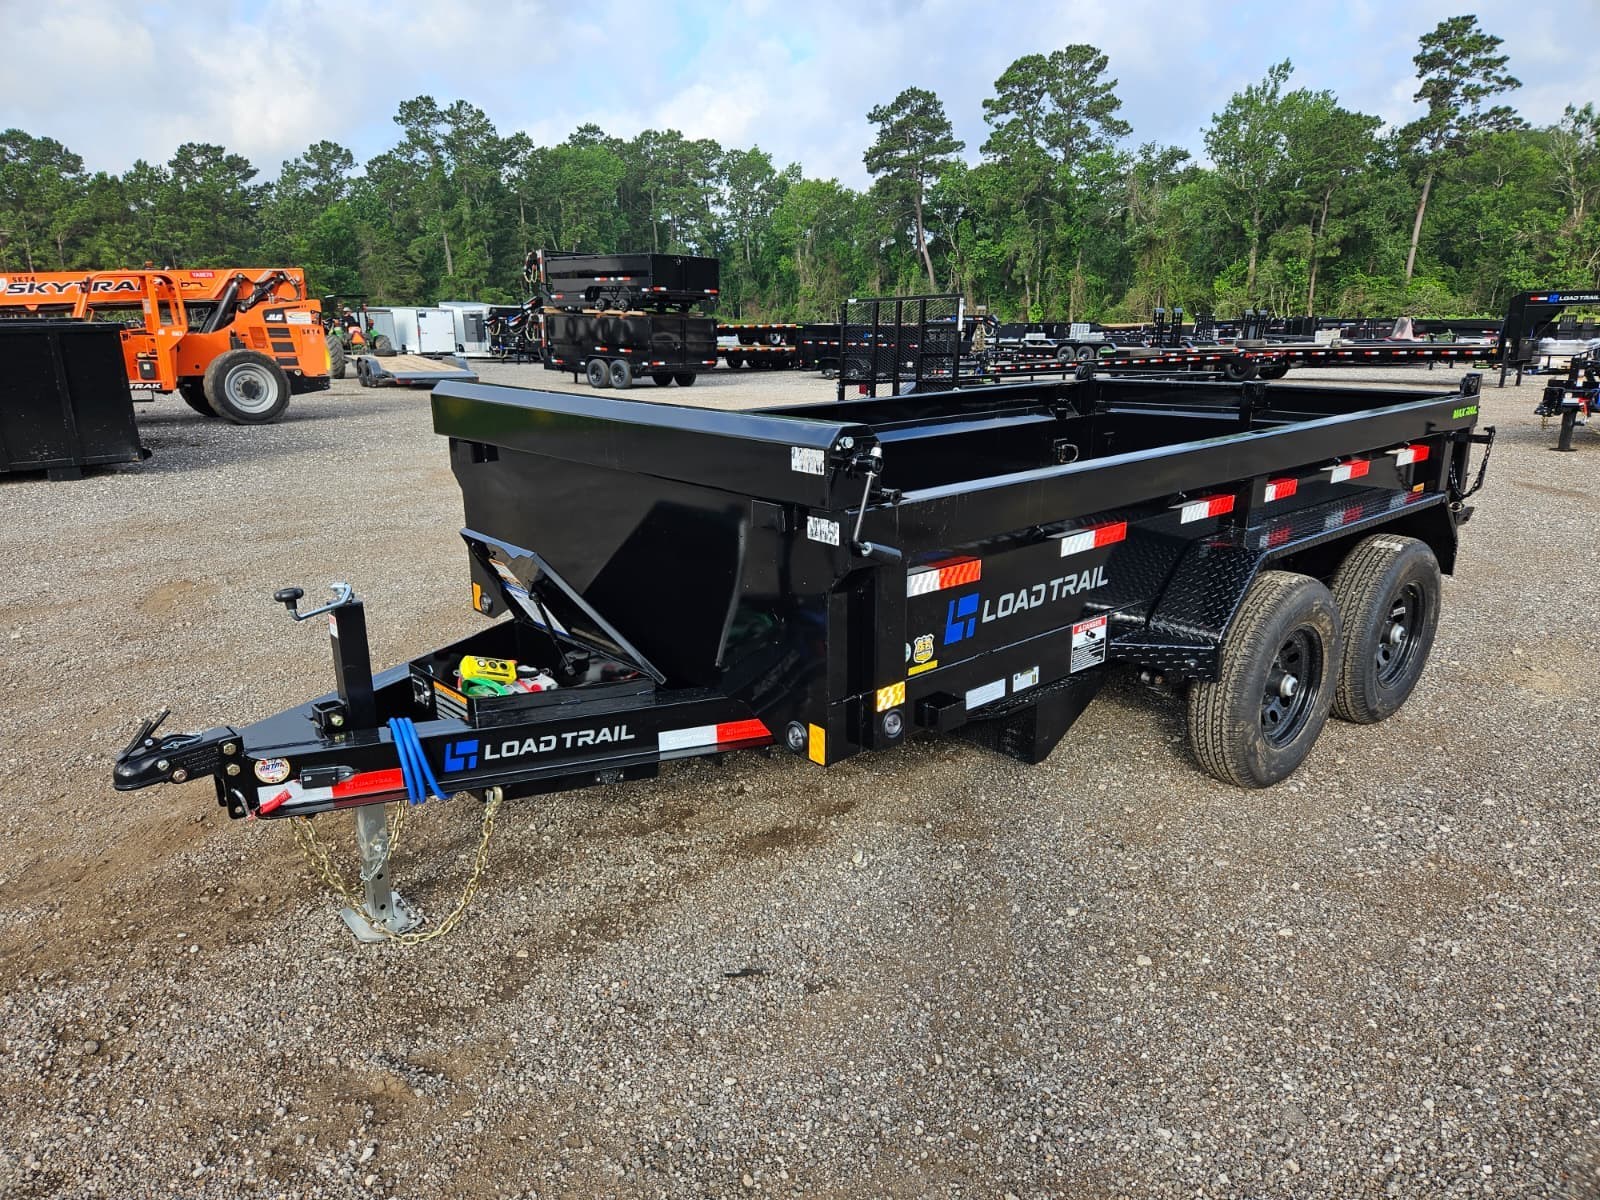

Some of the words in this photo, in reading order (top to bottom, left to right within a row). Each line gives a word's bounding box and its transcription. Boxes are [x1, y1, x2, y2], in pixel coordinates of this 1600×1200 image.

[266, 313, 284, 321] JLG
[982, 583, 1047, 623] LOAD
[1050, 565, 1109, 601] TRAIL
[484, 735, 557, 760] LOAD
[561, 724, 636, 748] TRAIL
